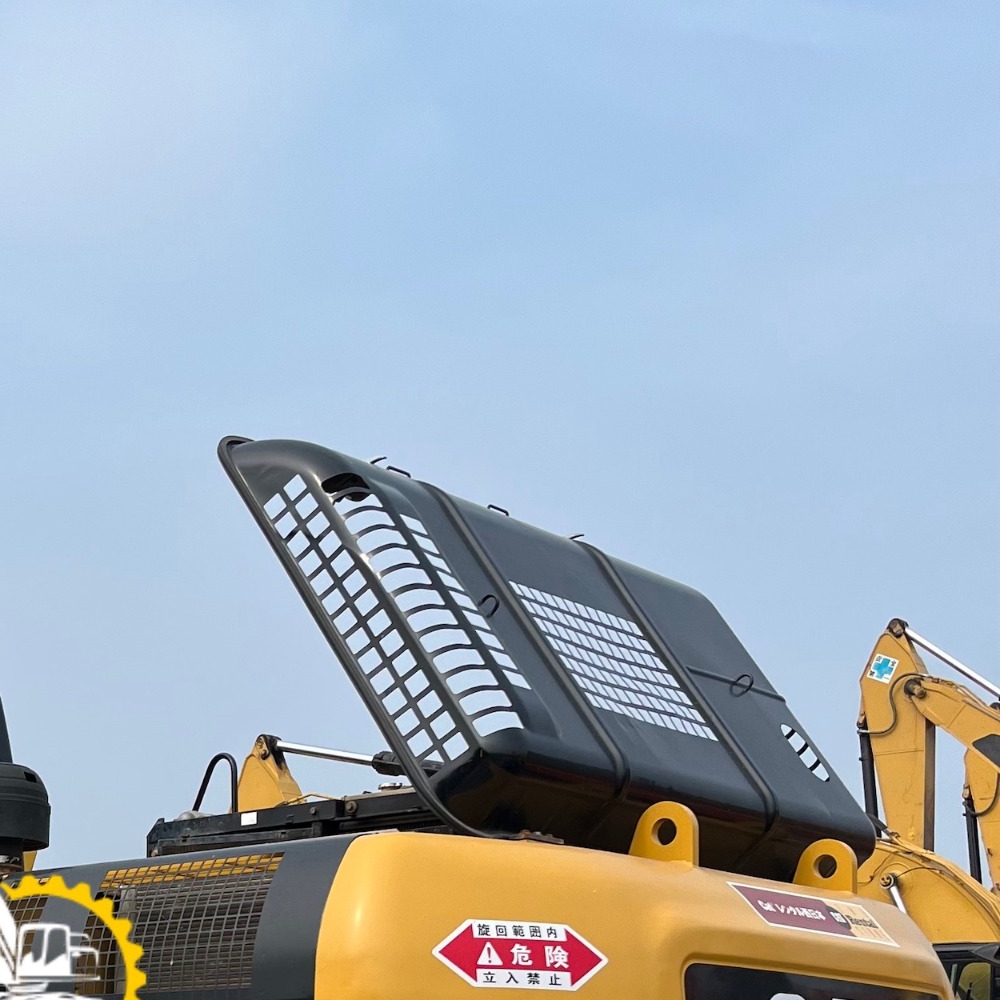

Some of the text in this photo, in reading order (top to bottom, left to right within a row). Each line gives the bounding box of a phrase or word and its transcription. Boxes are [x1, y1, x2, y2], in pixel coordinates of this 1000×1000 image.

[477, 924, 558, 939] 旋回範囲内
[510, 943, 569, 969] 危険
[483, 971, 562, 986] 立入禁止
